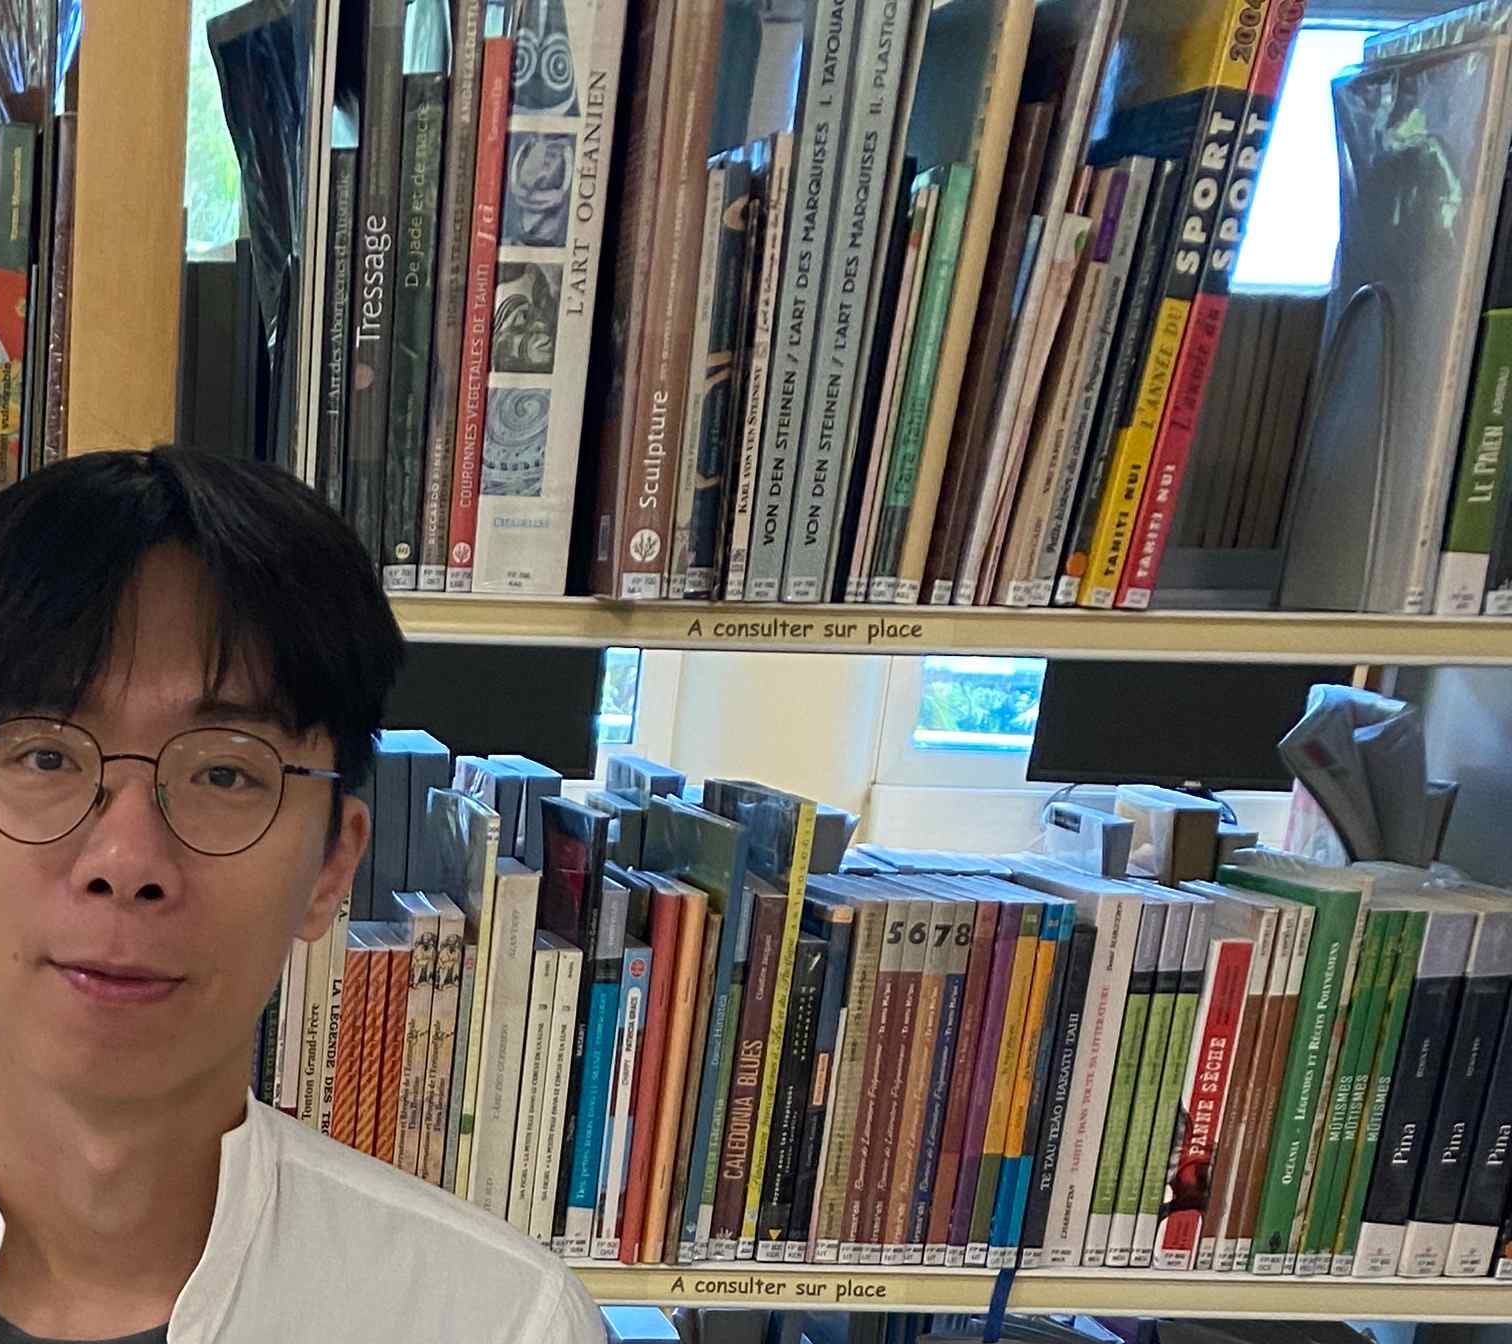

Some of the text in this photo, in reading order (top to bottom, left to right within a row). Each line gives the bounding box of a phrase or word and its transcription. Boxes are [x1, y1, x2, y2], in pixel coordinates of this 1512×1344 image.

[565, 70, 609, 317] L'ART OCÉANIEN
[1175, 111, 1236, 275] SPORT
[355, 214, 392, 348] Tressage
[639, 390, 670, 510] Sculpture
[687, 617, 923, 646] A consulter sur place
[723, 1039, 764, 1180] CALEDONIA BLUES
[1189, 1037, 1227, 1156] PANNE SÈCHE
[1392, 1122, 1418, 1166] Pina
[670, 1275, 887, 1301] A consulter sur place
